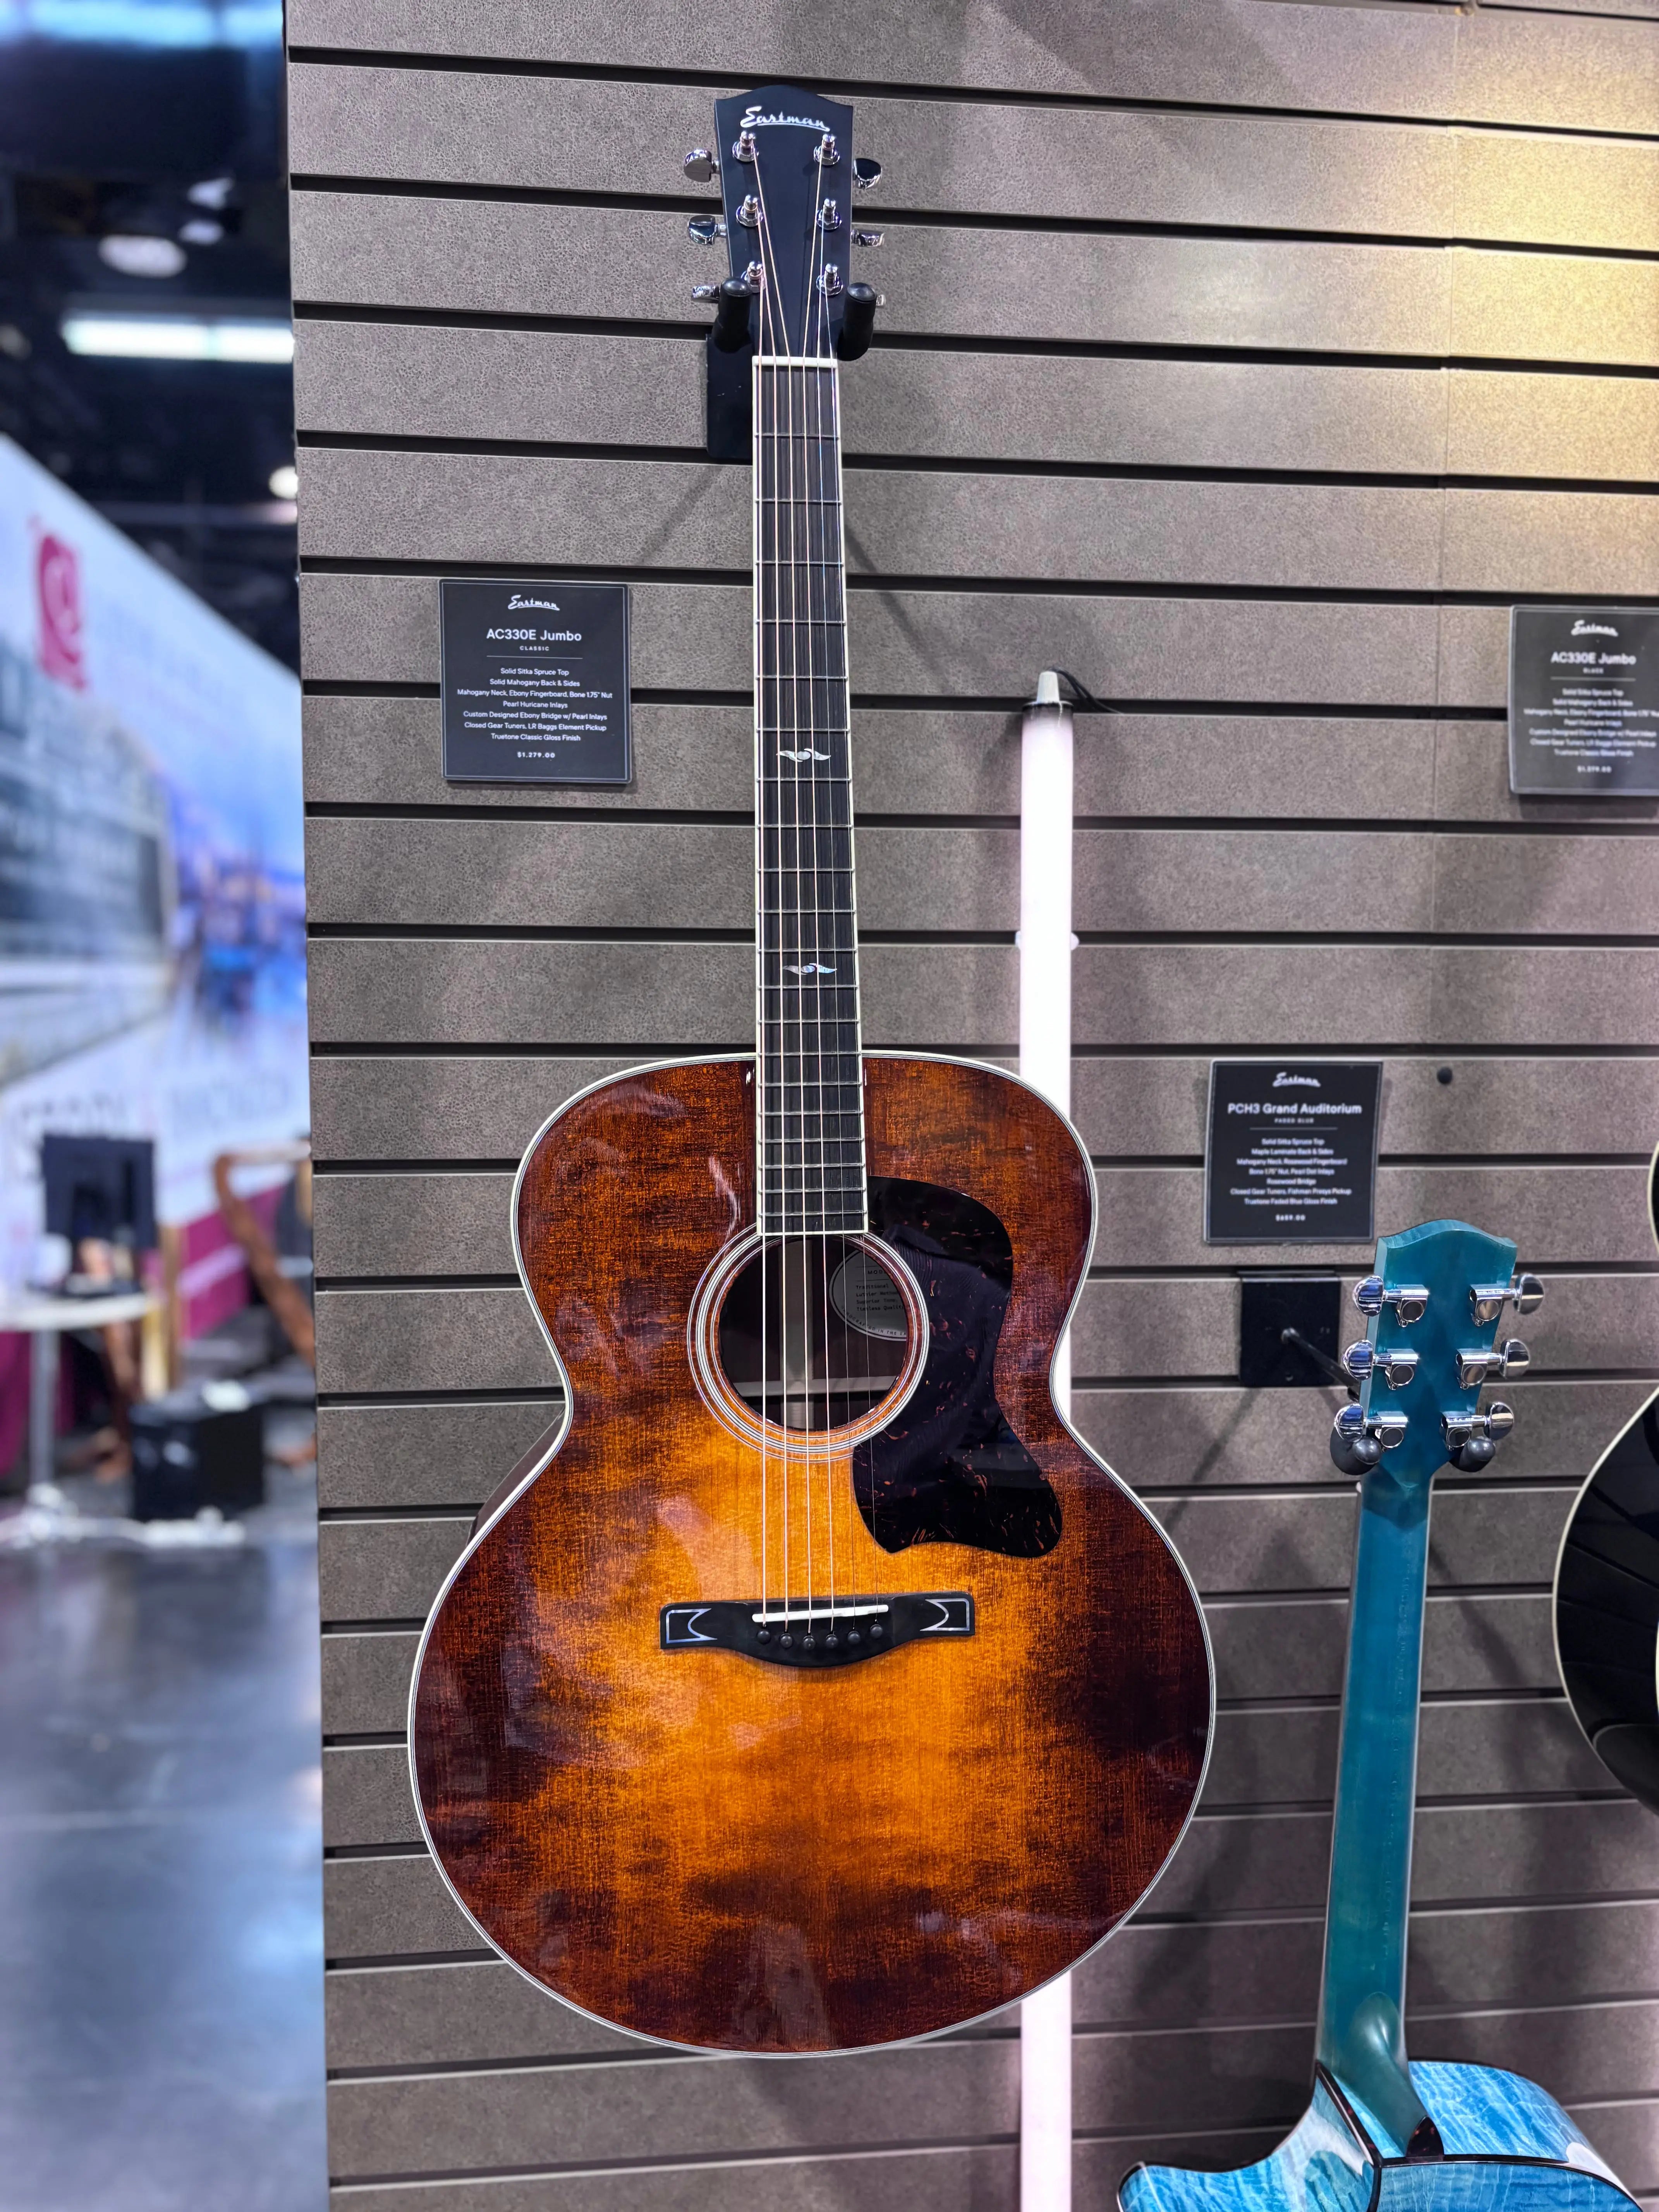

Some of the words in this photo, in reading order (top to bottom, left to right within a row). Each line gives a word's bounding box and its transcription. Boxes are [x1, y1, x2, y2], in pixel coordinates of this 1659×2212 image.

[740, 106, 830, 132] Eastman
[508, 594, 560, 611] Eastman
[486, 629, 536, 640] AC330E
[540, 630, 581, 641] Jumbo
[1551, 651, 1595, 664] AC330E
[1598, 653, 1637, 665] Jumbo
[489, 711, 519, 719] Designed
[1272, 1072, 1321, 1087] Eastman
[1228, 1103, 1260, 1114] PCH3
[1262, 1103, 1298, 1114] Grand
[1300, 1103, 1362, 1114] Auditorium
